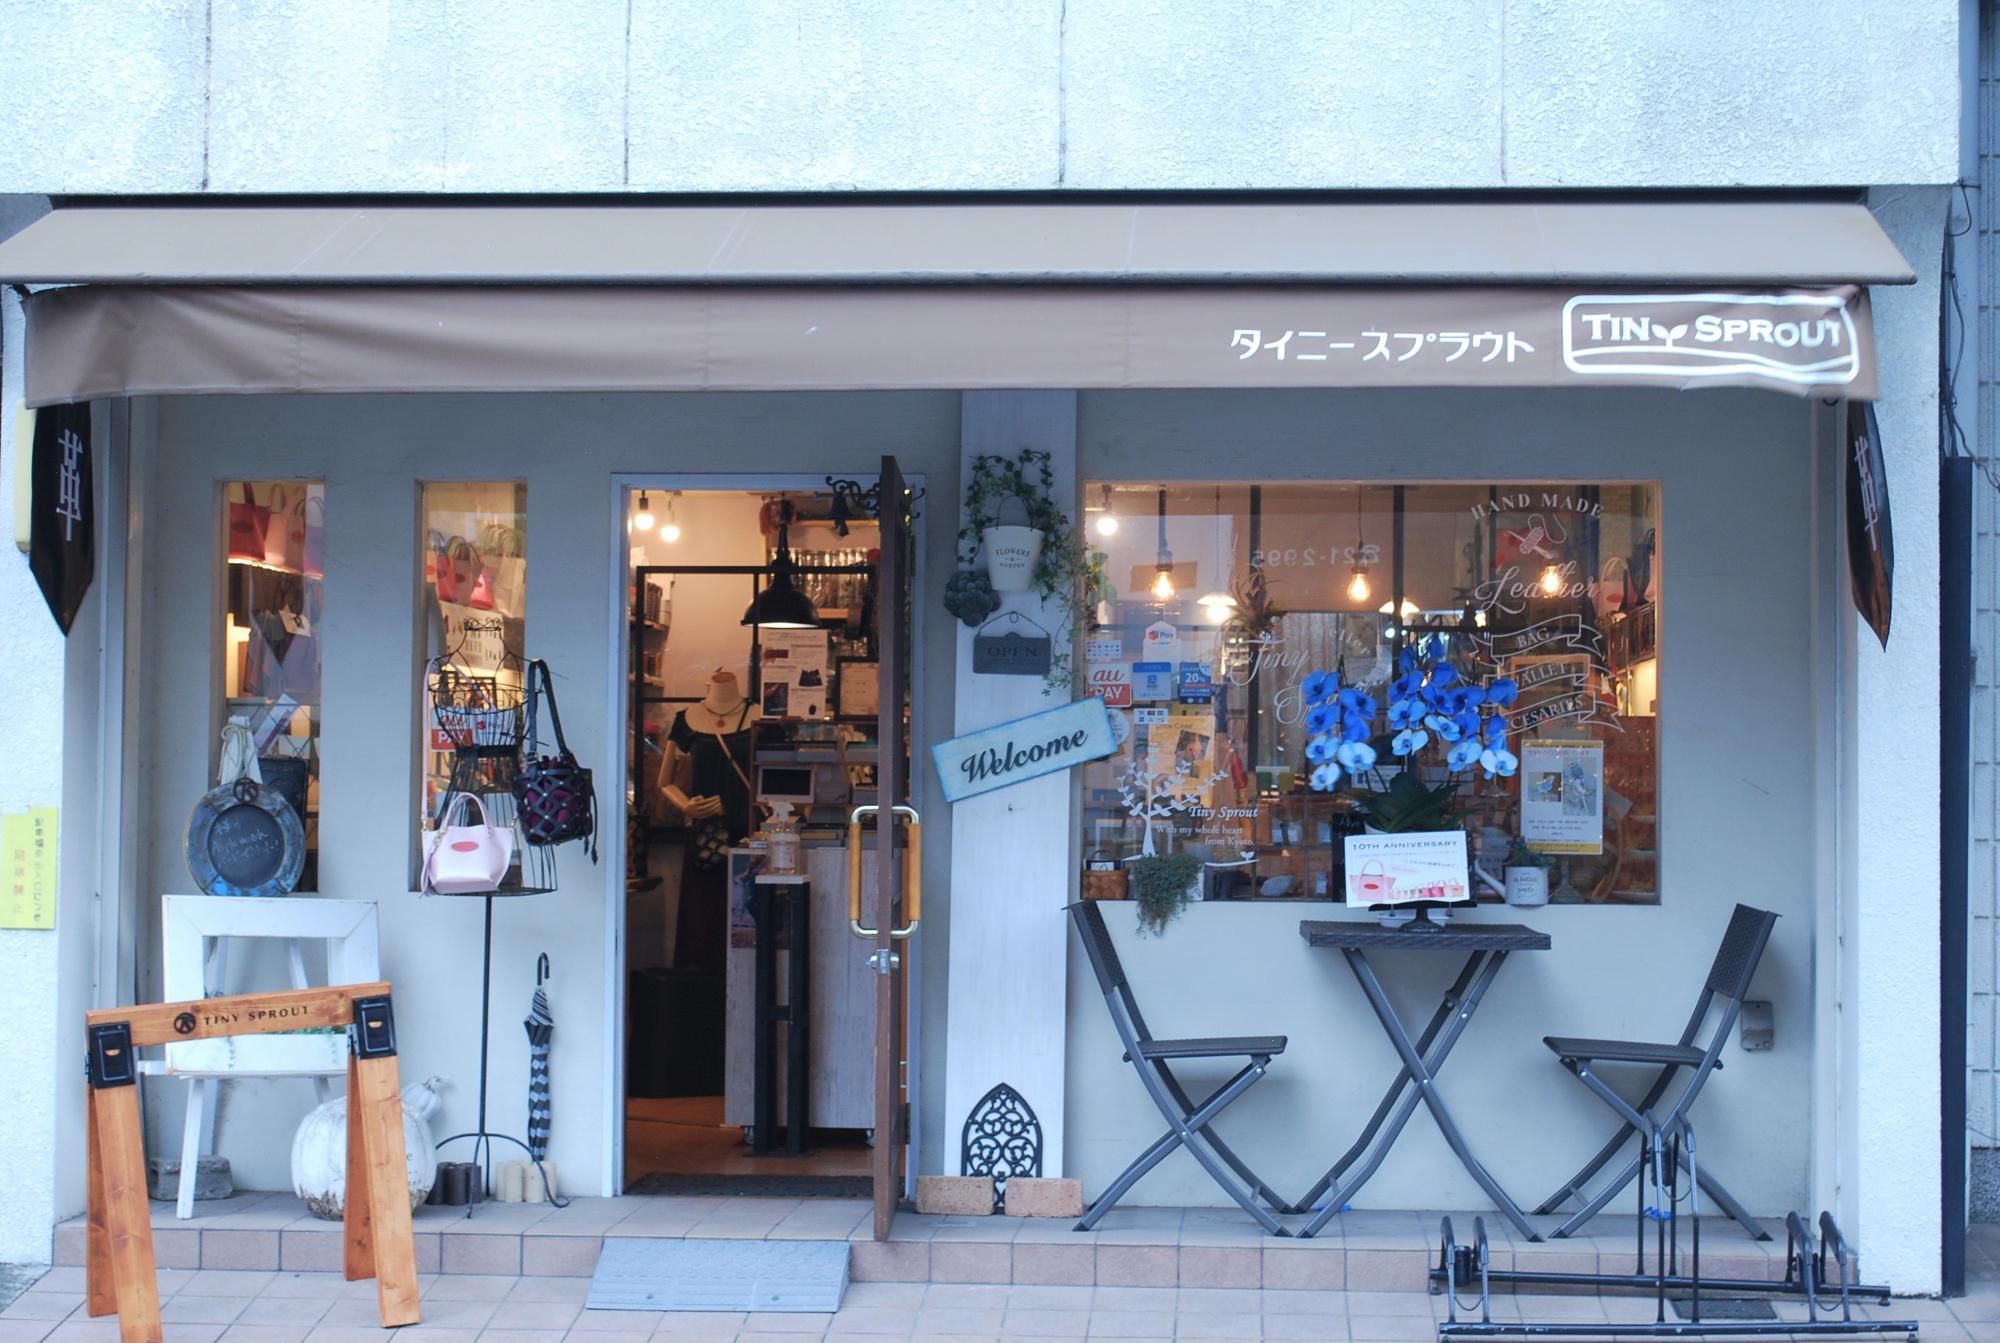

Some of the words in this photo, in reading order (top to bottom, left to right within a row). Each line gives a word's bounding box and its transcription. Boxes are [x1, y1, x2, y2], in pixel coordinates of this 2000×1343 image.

[1694, 314, 1841, 348] SPROUT
[1230, 329, 1536, 363] タイニースプラウト
[56, 427, 84, 542] 革
[1854, 435, 1879, 552] 革
[1471, 494, 1530, 521] HAND
[1541, 492, 1604, 520] MADE
[995, 547, 1031, 557] FLOWERS
[1516, 627, 1550, 648] BAG
[988, 646, 1038, 657] OPEN
[1229, 637, 1312, 687] Tiny
[1093, 669, 1125, 682] au
[1516, 663, 1567, 686] ALLET
[1095, 685, 1124, 699] PAY
[1510, 694, 1583, 729] CESARIES
[960, 729, 1088, 784] Welcome
[1188, 806, 1216, 821] Tiny
[1218, 806, 1259, 821] Sprout
[1179, 827, 1193, 836] my
[1195, 825, 1220, 834] whole
[1222, 825, 1243, 834] heart
[1205, 836, 1225, 846] from
[1227, 837, 1256, 848] Kyoto.
[1383, 840, 1458, 849] ANNIVERSARY
[203, 1013, 240, 1026] TINY
[248, 1005, 309, 1021] SPROUT
